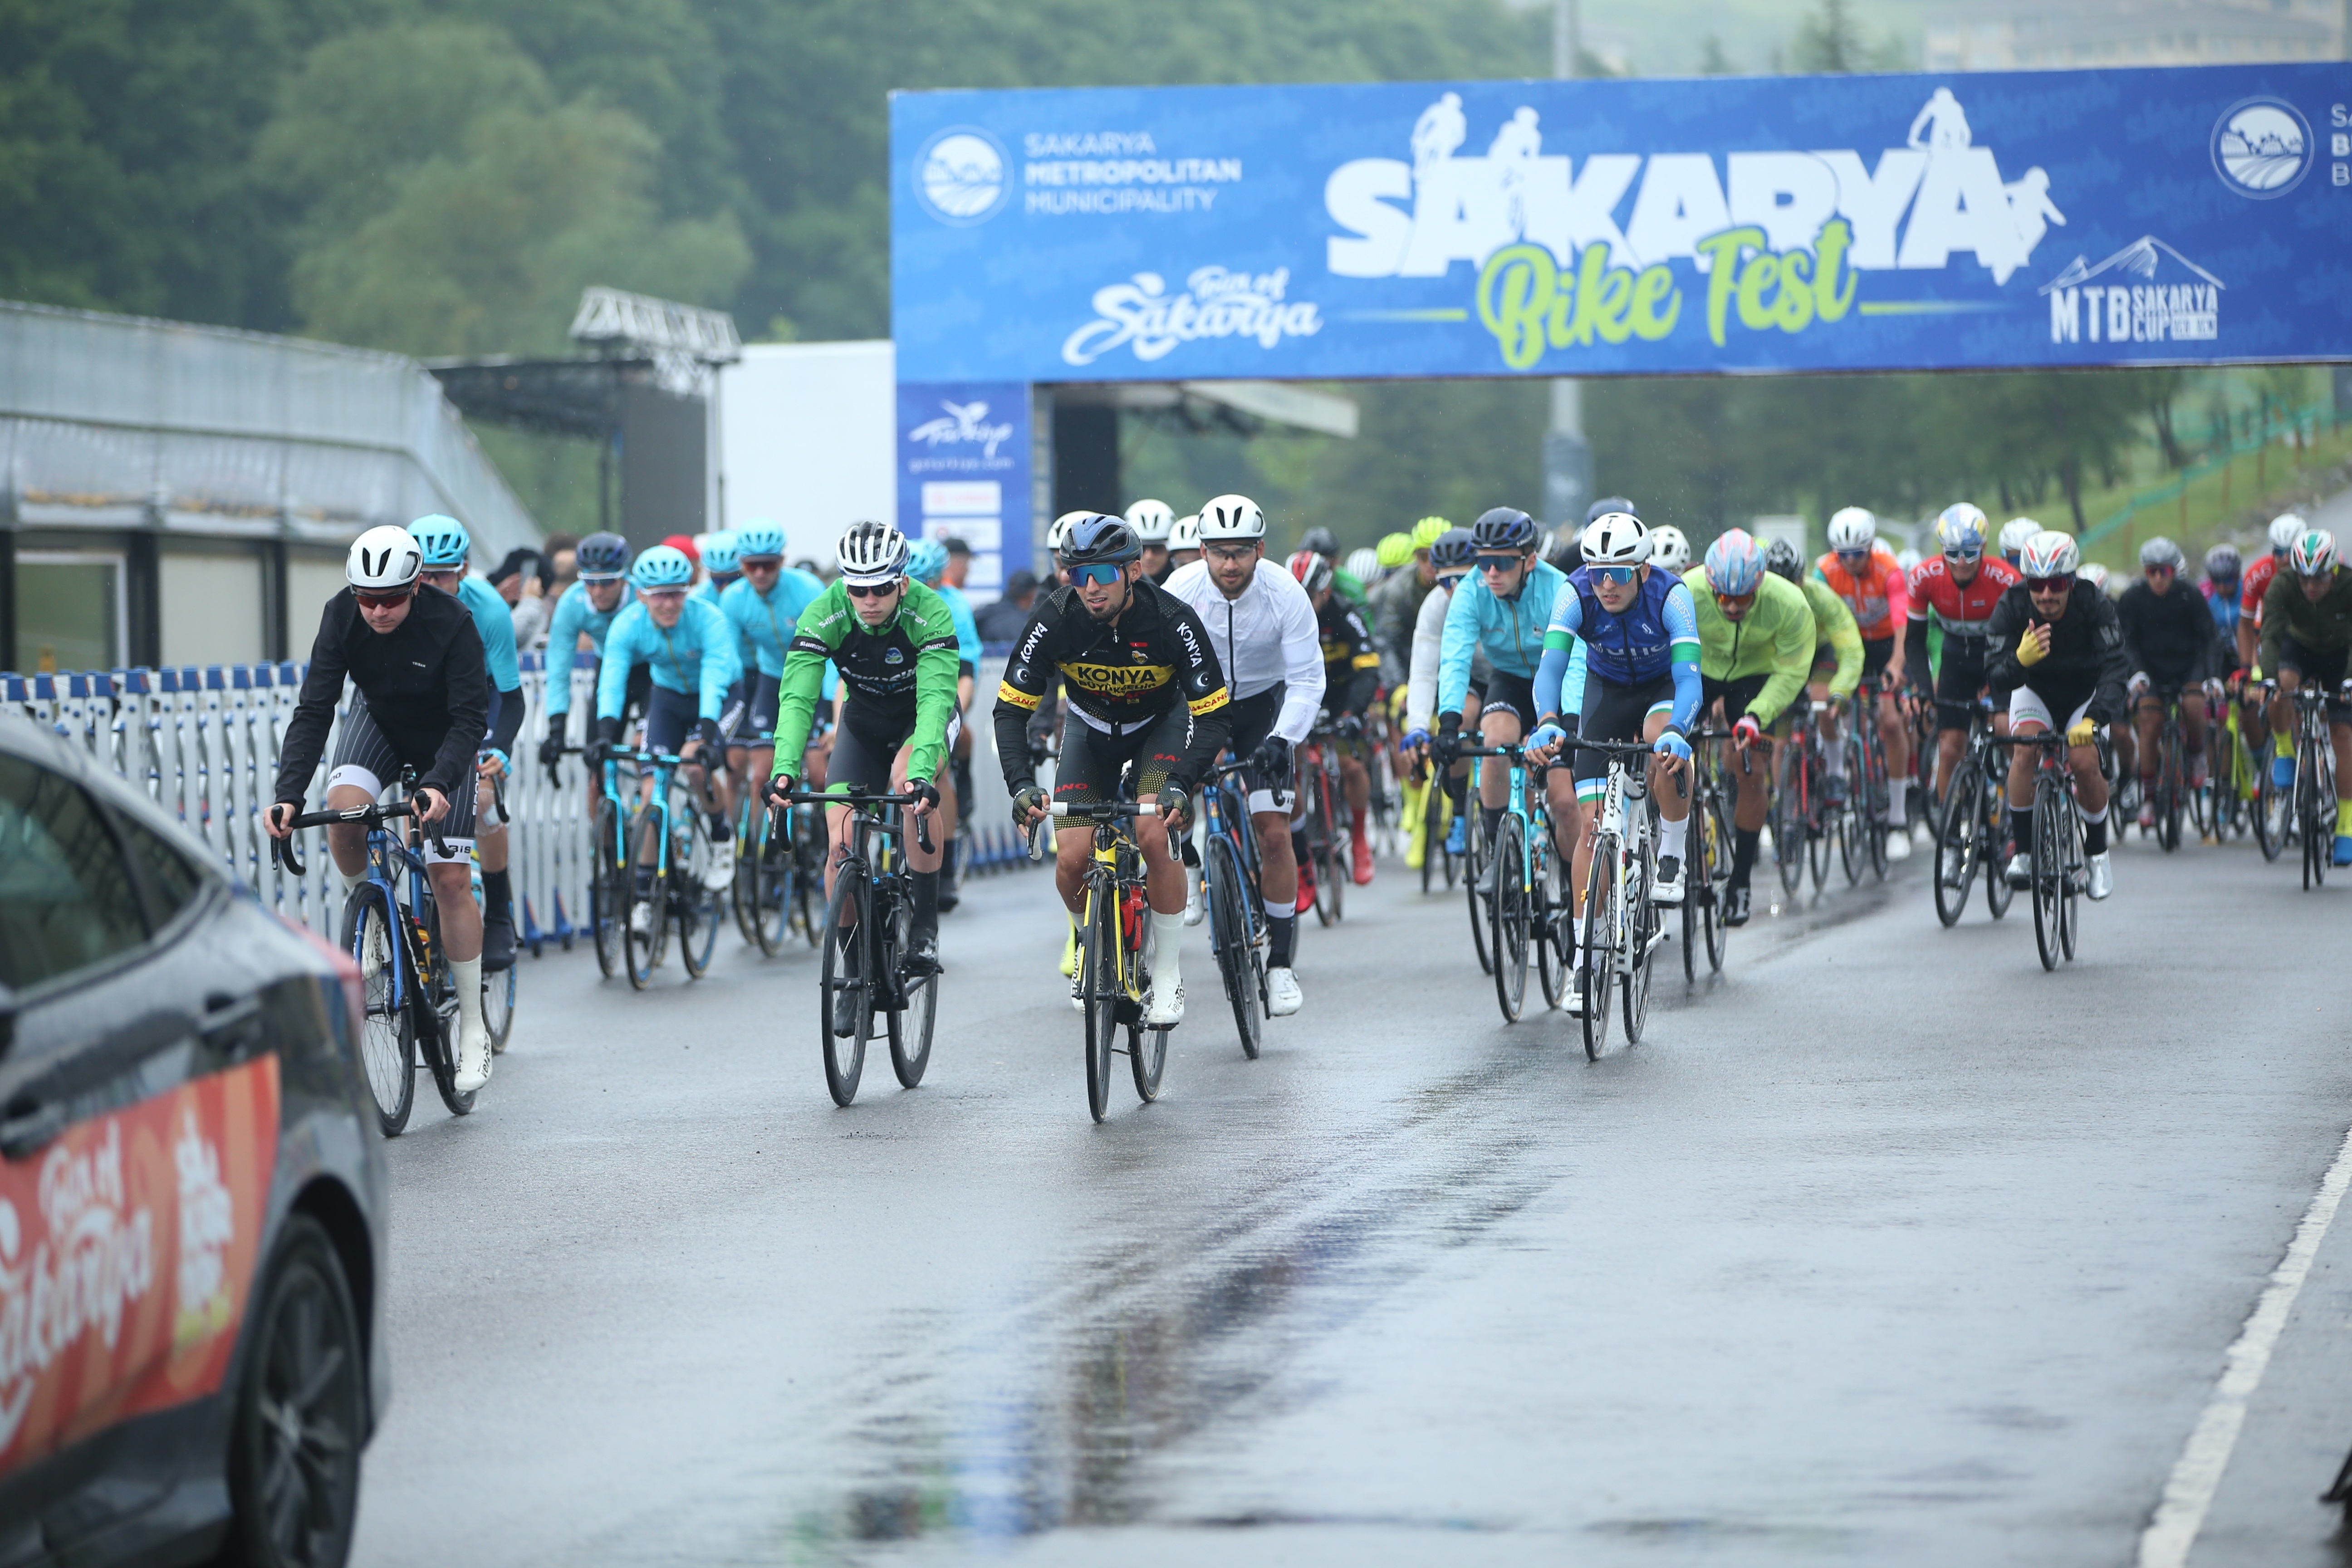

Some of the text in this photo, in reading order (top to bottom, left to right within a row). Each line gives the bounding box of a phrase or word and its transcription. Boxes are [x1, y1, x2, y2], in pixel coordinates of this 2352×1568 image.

[1024, 132, 1156, 158] SAKARYA
[1025, 159, 1242, 186] METROPOLITAN
[1024, 188, 1219, 215] MUNICIPALITY
[1324, 146, 2030, 279] SAKARYA
[1476, 219, 1858, 370] Bike Fest
[2132, 283, 2218, 313] SAKARYA
[1061, 272, 1324, 367] Sakarya
[2050, 285, 2132, 344] MTB
[2132, 313, 2171, 343] CUP
[1984, 563, 2014, 588] IRA
[1020, 622, 1049, 664] KONYA
[1176, 622, 1202, 668] KONYA
[1078, 666, 1157, 685] KONYA
